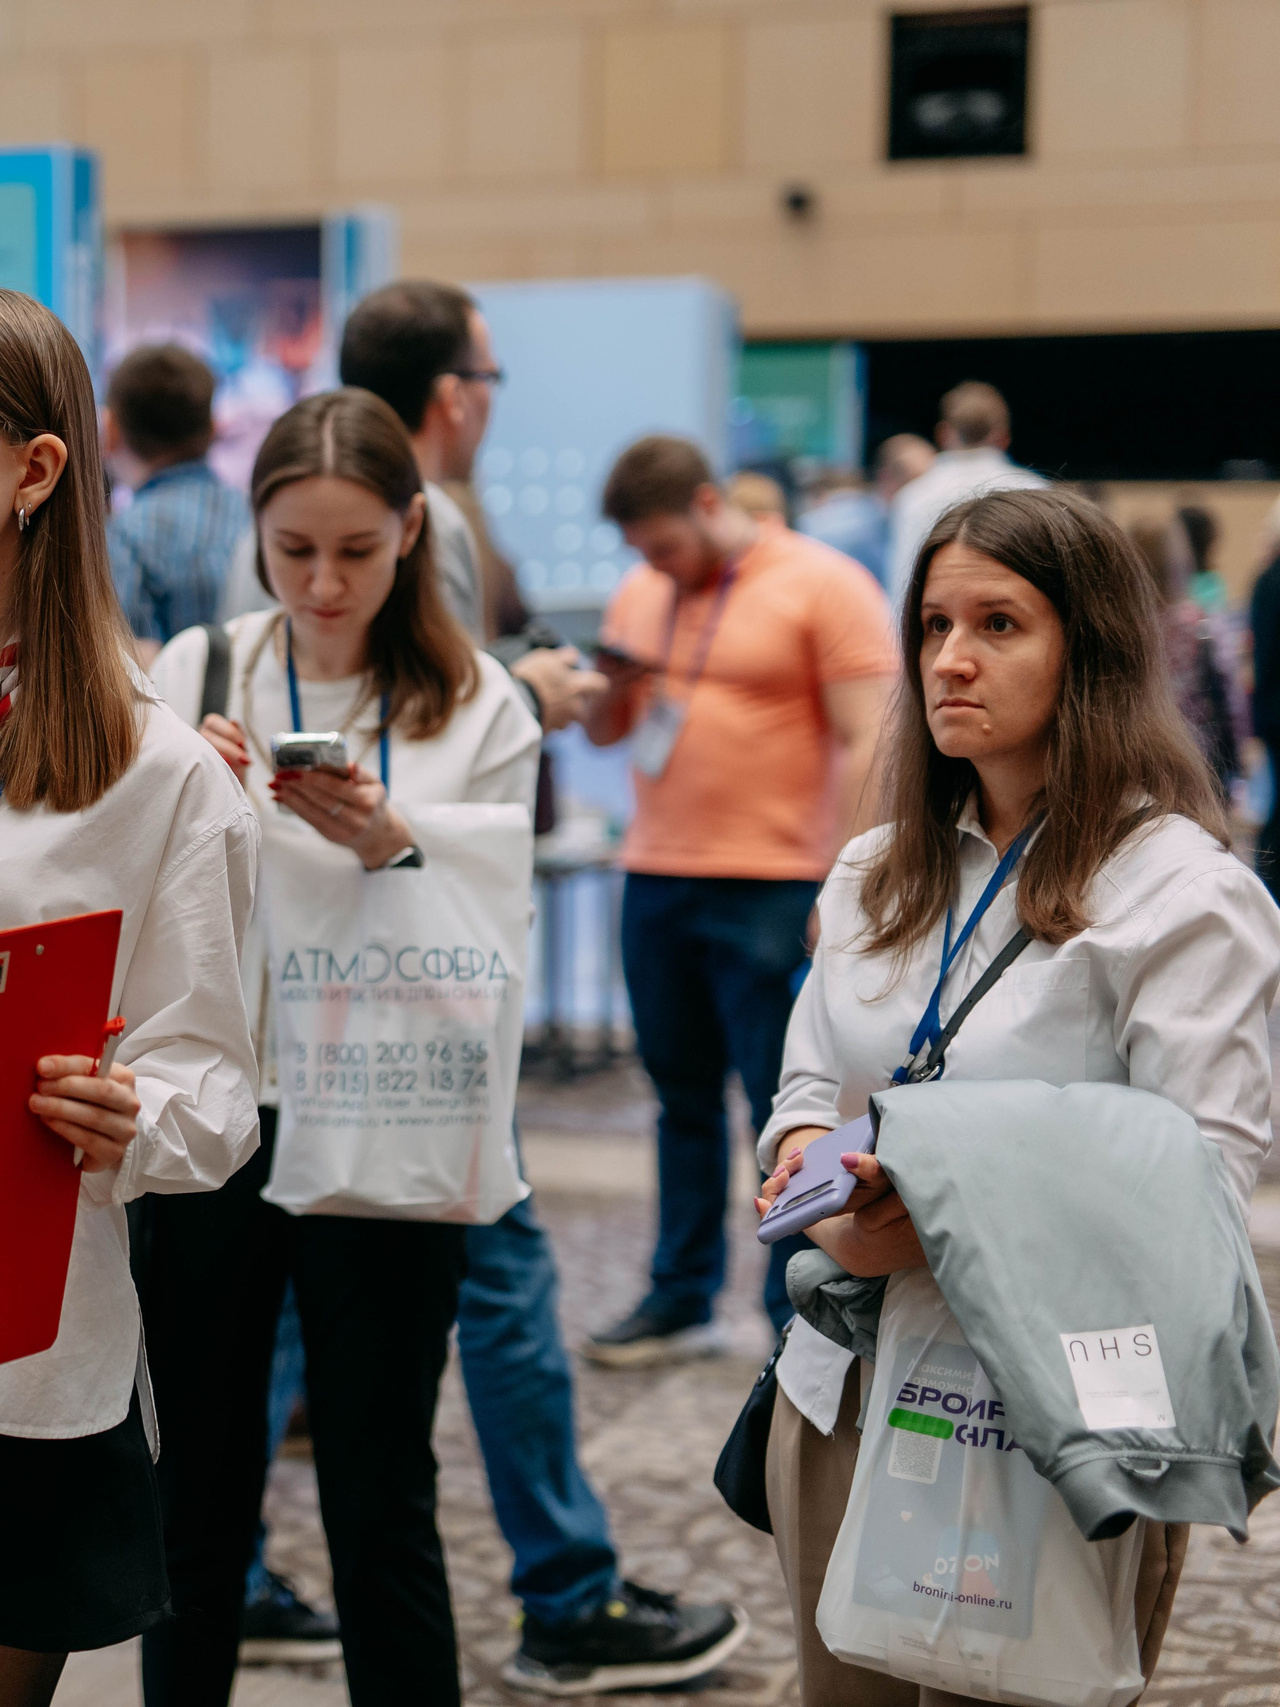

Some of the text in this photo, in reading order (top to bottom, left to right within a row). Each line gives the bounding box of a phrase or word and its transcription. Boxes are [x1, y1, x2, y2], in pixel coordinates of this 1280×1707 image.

[281, 943, 510, 983] АТМОСФЕРА
[317, 1041, 368, 1067] (800)
[376, 1041, 418, 1065] 200
[425, 1040, 453, 1063] 96
[460, 1040, 488, 1063] 55
[295, 1069, 308, 1092] 8
[317, 1069, 368, 1095] (915)
[376, 1069, 418, 1093] 822
[461, 1068, 488, 1091] 74
[1069, 1333, 1152, 1362] SHU
